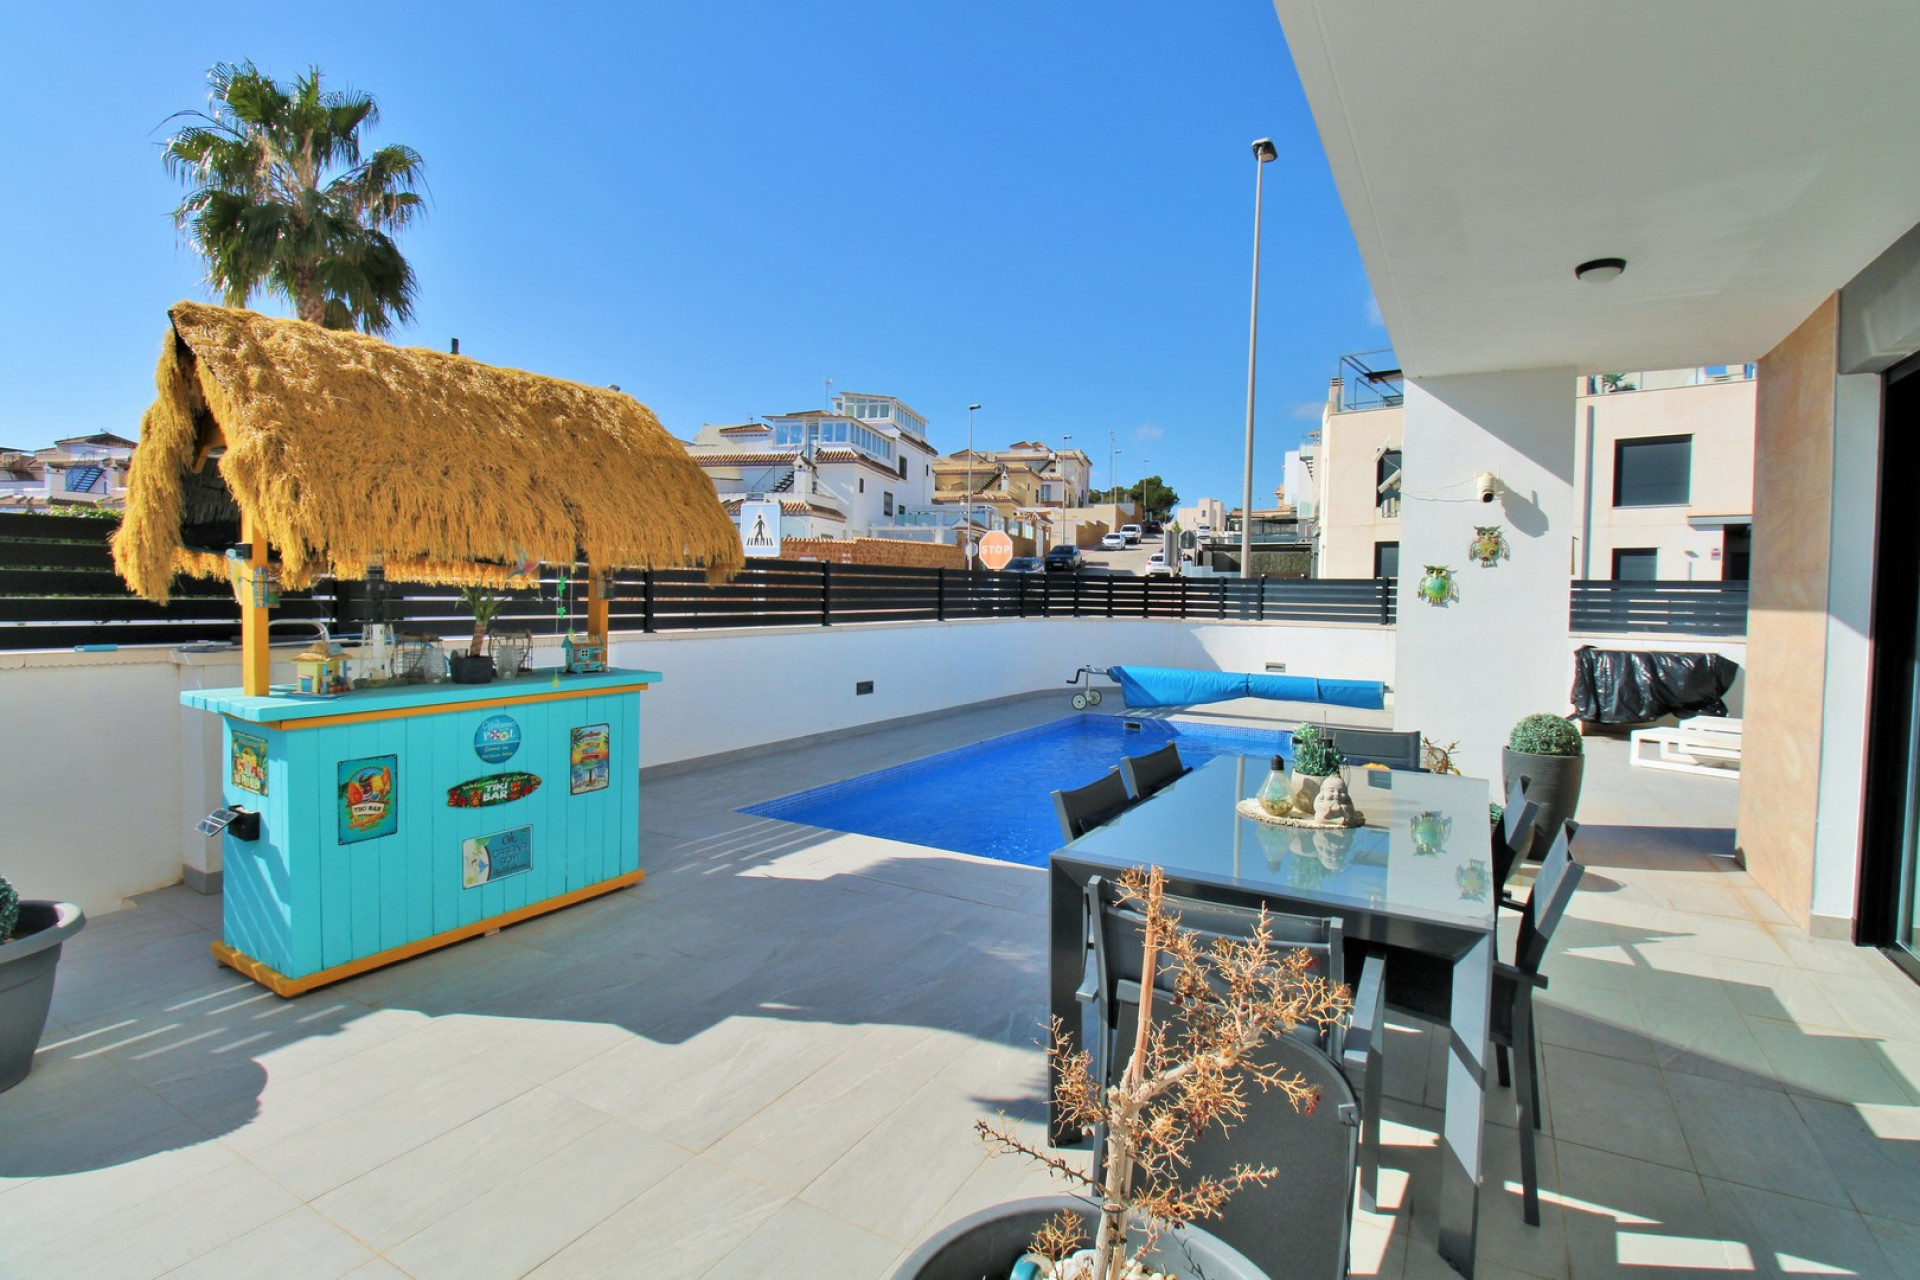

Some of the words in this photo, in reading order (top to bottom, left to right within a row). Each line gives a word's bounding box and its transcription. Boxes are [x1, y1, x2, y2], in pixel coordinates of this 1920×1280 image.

[981, 544, 1011, 555] STOP
[485, 781, 508, 792] TIKI
[482, 791, 508, 802] BAR
